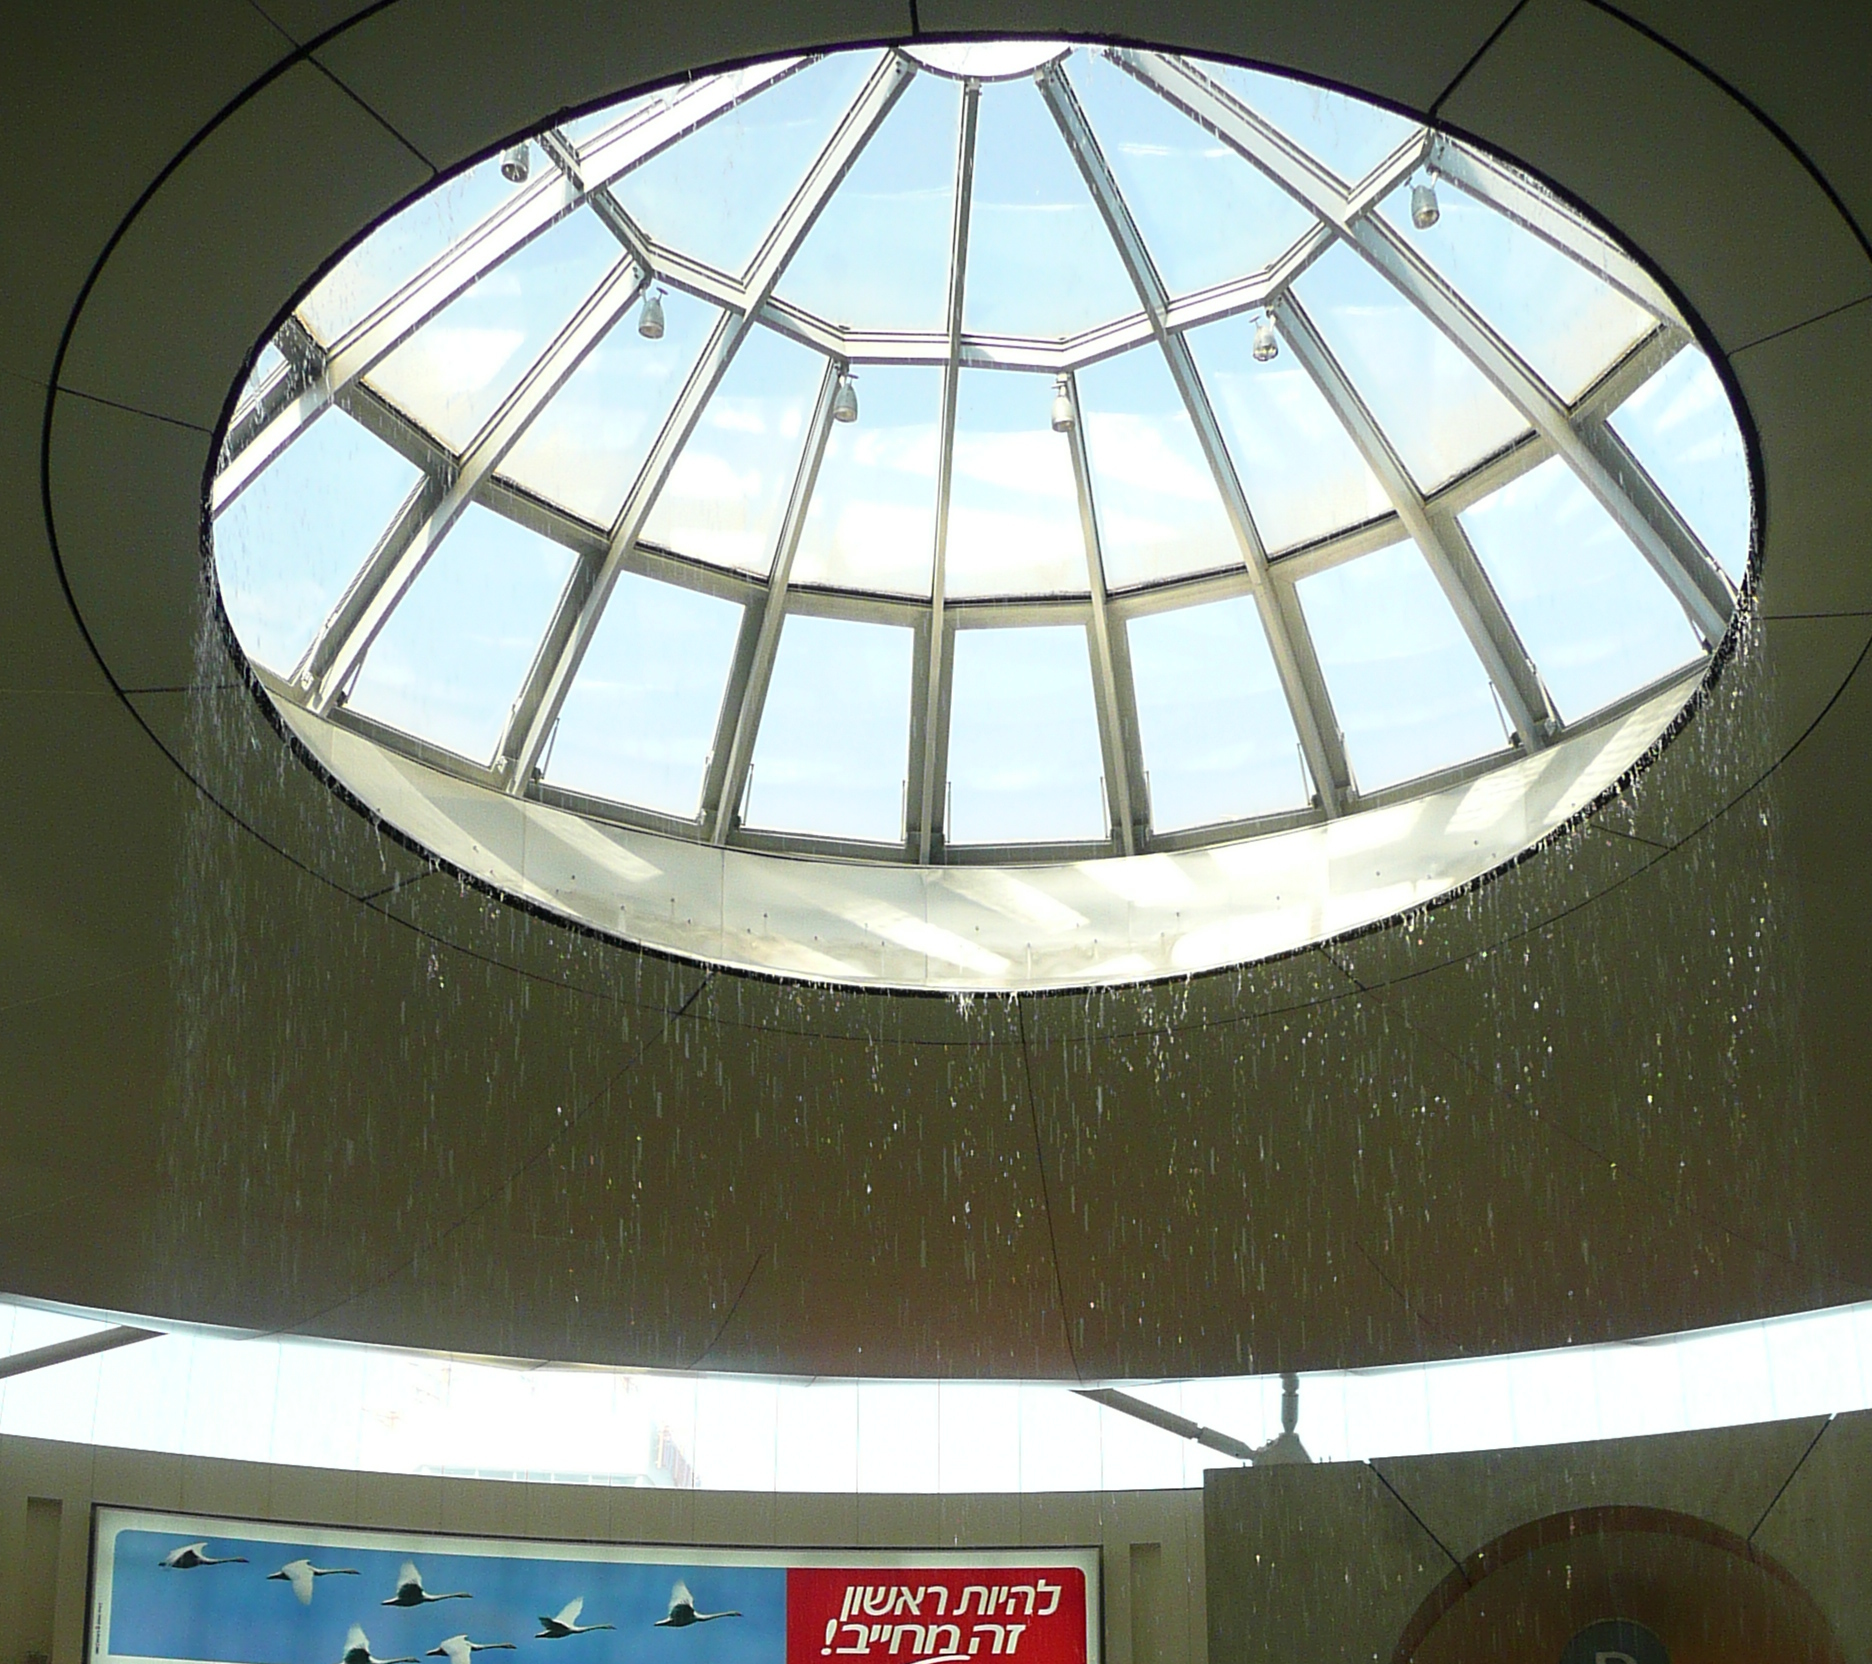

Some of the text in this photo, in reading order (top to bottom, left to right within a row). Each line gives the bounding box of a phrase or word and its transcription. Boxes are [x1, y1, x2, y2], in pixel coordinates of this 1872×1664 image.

[840, 1579, 1062, 1621] להיות ראשון
[820, 1618, 1026, 1656] זה מחייב!
